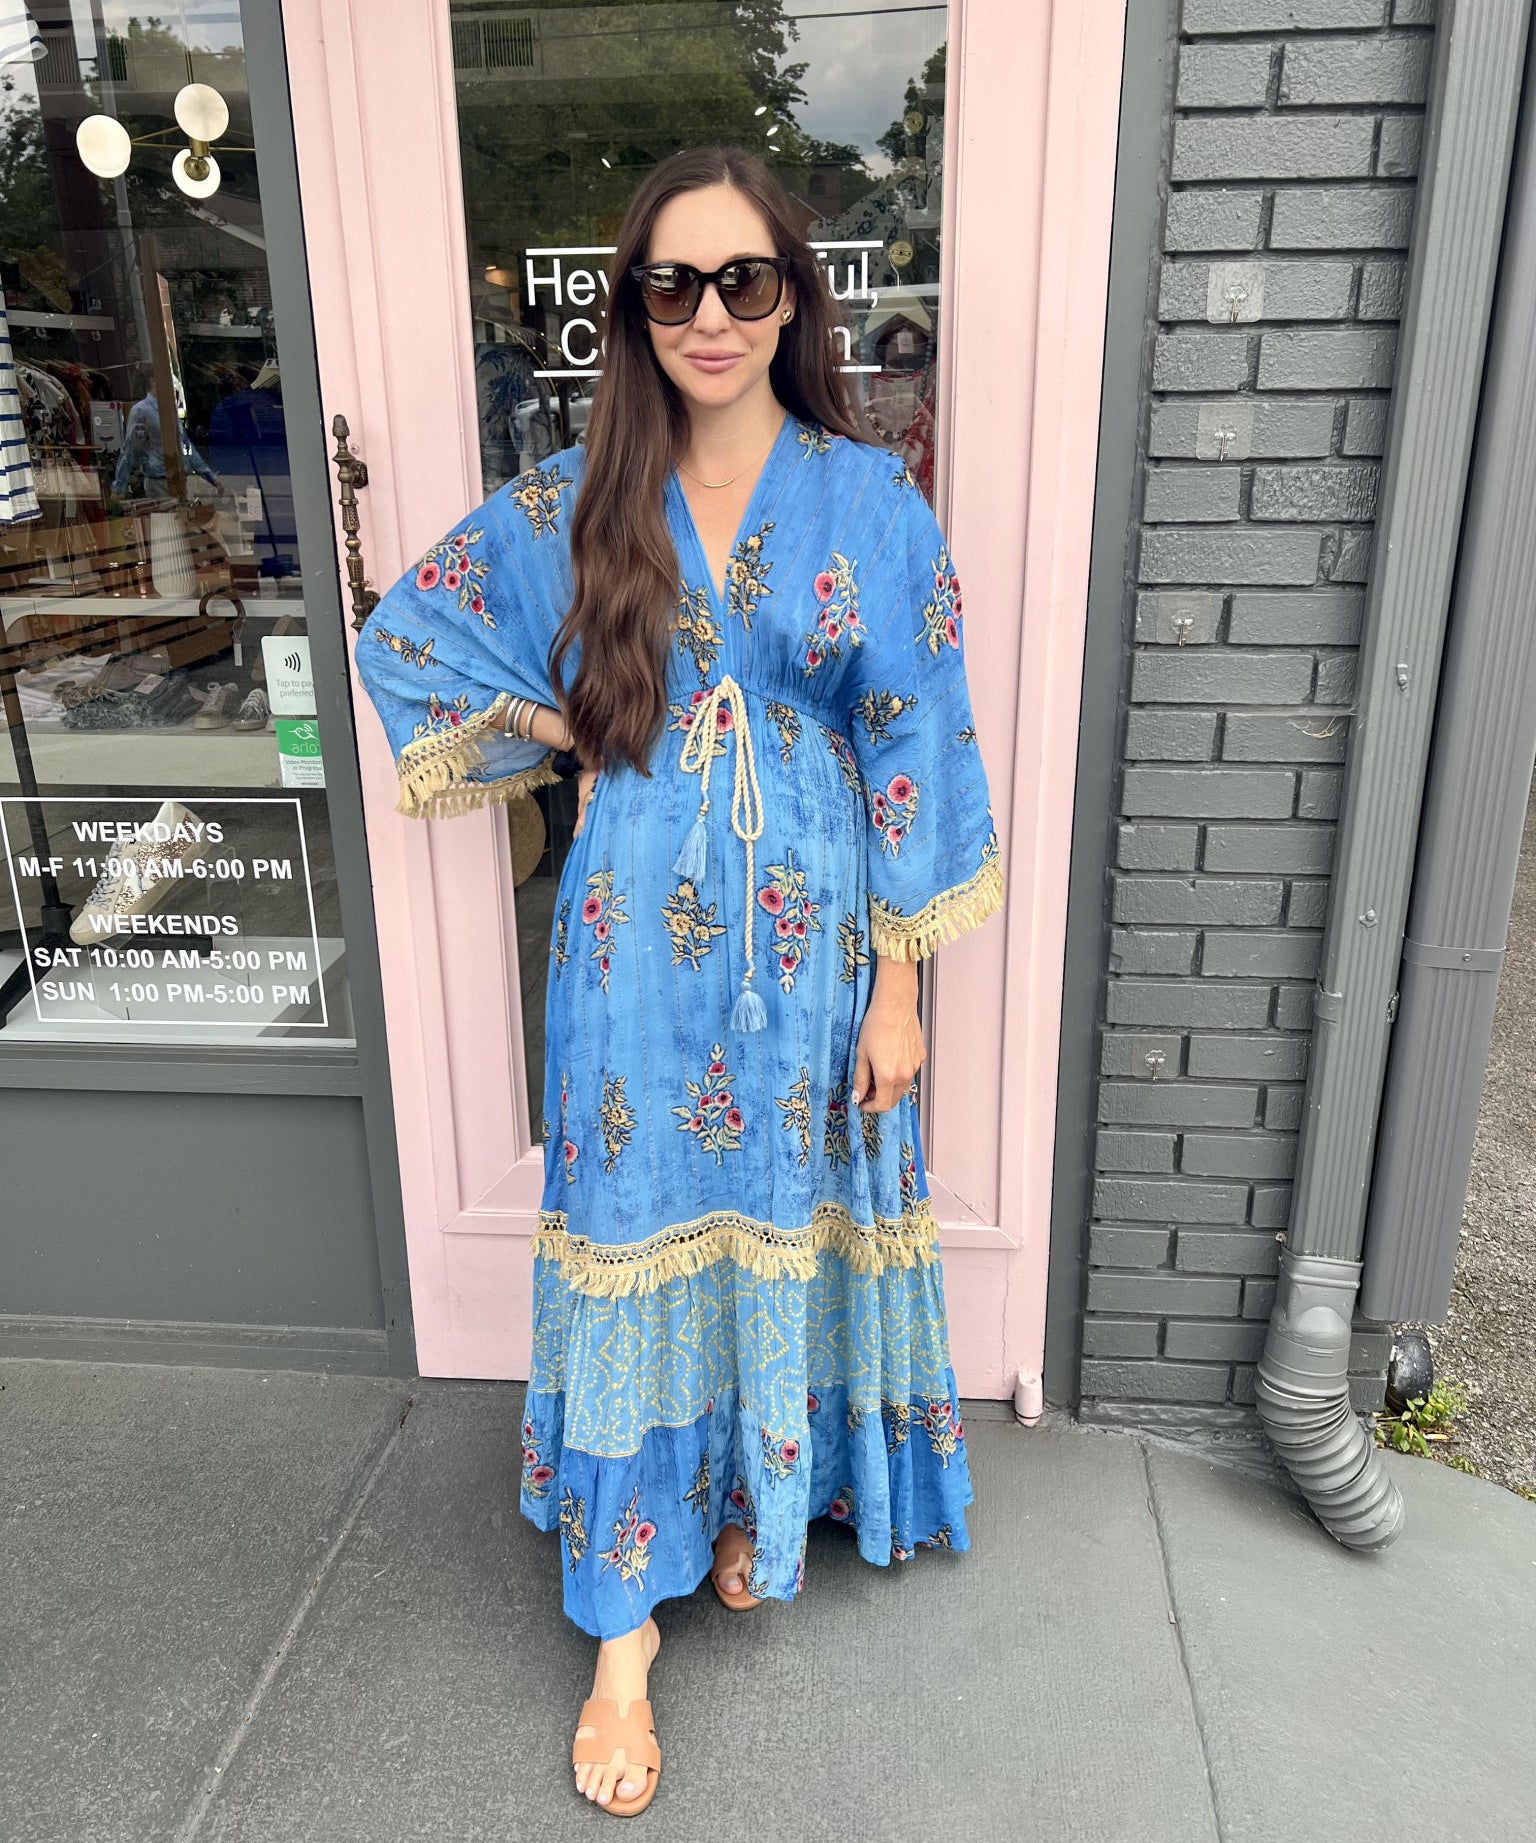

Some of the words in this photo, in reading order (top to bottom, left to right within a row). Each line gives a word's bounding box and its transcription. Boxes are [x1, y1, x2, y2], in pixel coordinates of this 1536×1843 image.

[280, 690, 314, 698] preferred
[291, 741, 318, 754] arlo
[72, 821, 224, 843] WEEKDAYS
[18, 856, 64, 878] M-F
[72, 857, 137, 878] 11:00
[144, 858, 245, 879] AM-6:00
[252, 859, 293, 880] PM
[88, 914, 239, 936] WEEKENDS
[33, 947, 82, 968] SAT
[90, 948, 155, 969] 10:00
[161, 949, 261, 970] AM-5:00
[268, 951, 308, 971] PM
[42, 981, 95, 1001] SUN
[109, 982, 160, 1003] 1:00
[166, 983, 265, 1004] PM-5:00
[271, 985, 311, 1005] PM
